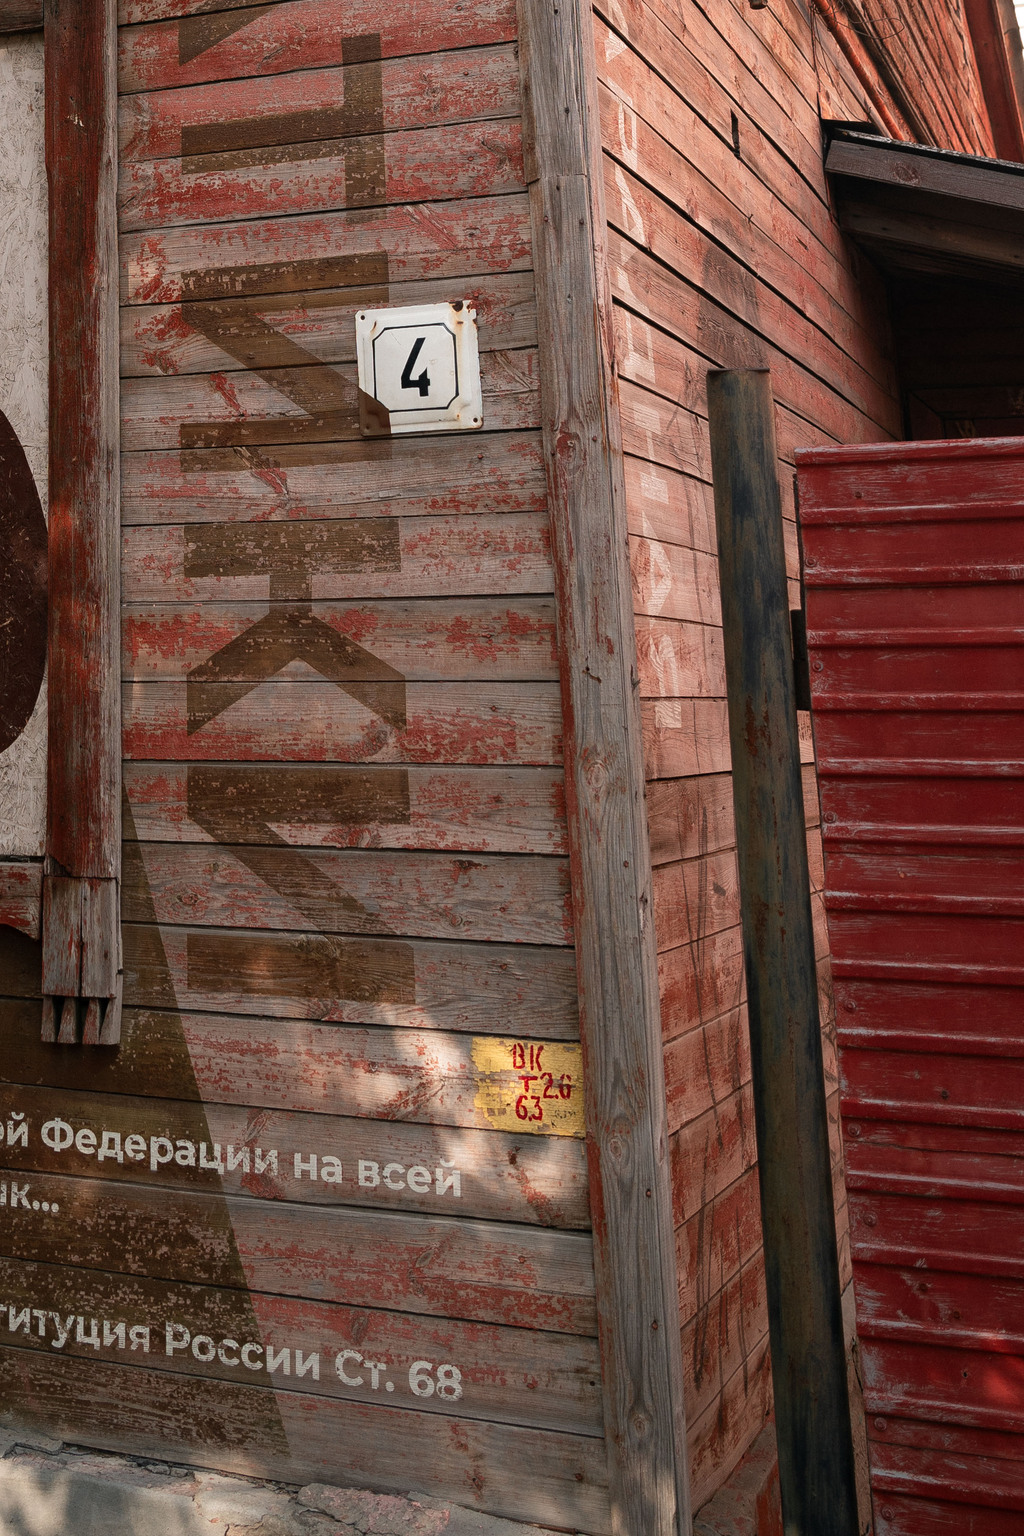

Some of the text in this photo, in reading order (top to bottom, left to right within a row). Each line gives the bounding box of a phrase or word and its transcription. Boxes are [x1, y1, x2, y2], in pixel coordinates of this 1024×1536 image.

[398, 334, 433, 399] 4
[40, 1116, 278, 1175] Федерации
[293, 1152, 343, 1185] на
[357, 1159, 463, 1198] всей
[164, 1321, 322, 1381] России
[336, 1348, 395, 1393] Ст.
[408, 1360, 464, 1403] 68
